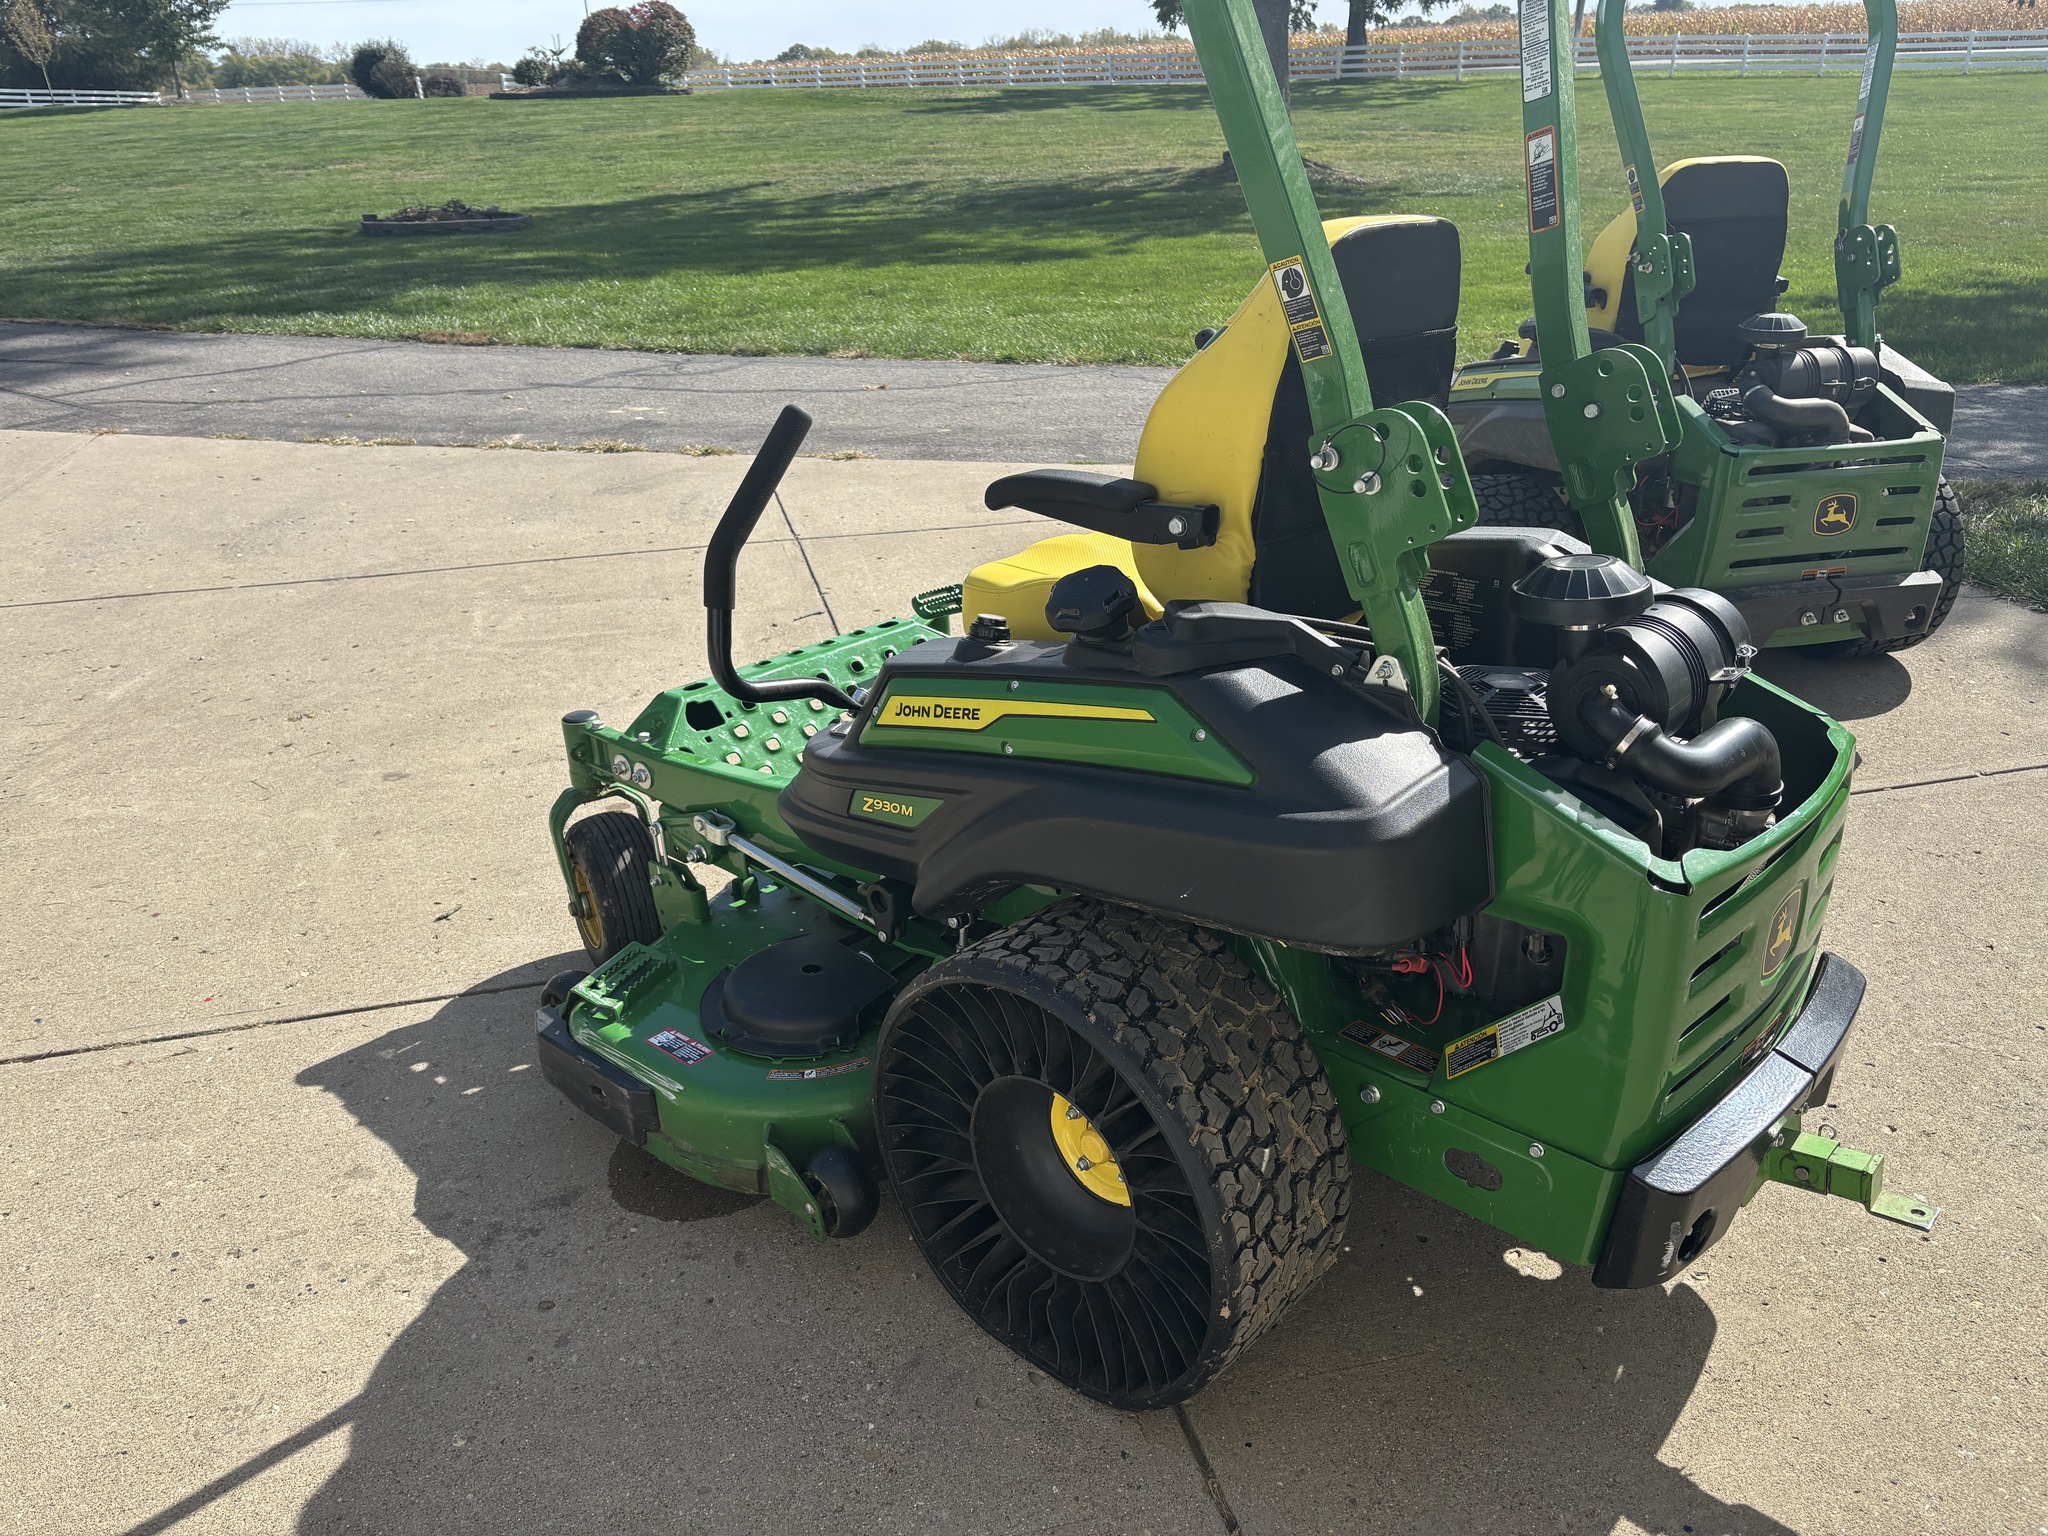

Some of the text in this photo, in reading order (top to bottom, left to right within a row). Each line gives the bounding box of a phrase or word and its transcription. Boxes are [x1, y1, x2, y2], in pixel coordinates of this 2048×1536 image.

[1277, 257, 1299, 269] CAUTION
[1296, 319, 1321, 331] ATENCIÓN
[1458, 377, 1489, 386] JOHN DEERE
[895, 702, 980, 720] JOHN DEERE
[862, 797, 914, 818] Z930M
[1460, 1030, 1488, 1048] ATENCIÓN
